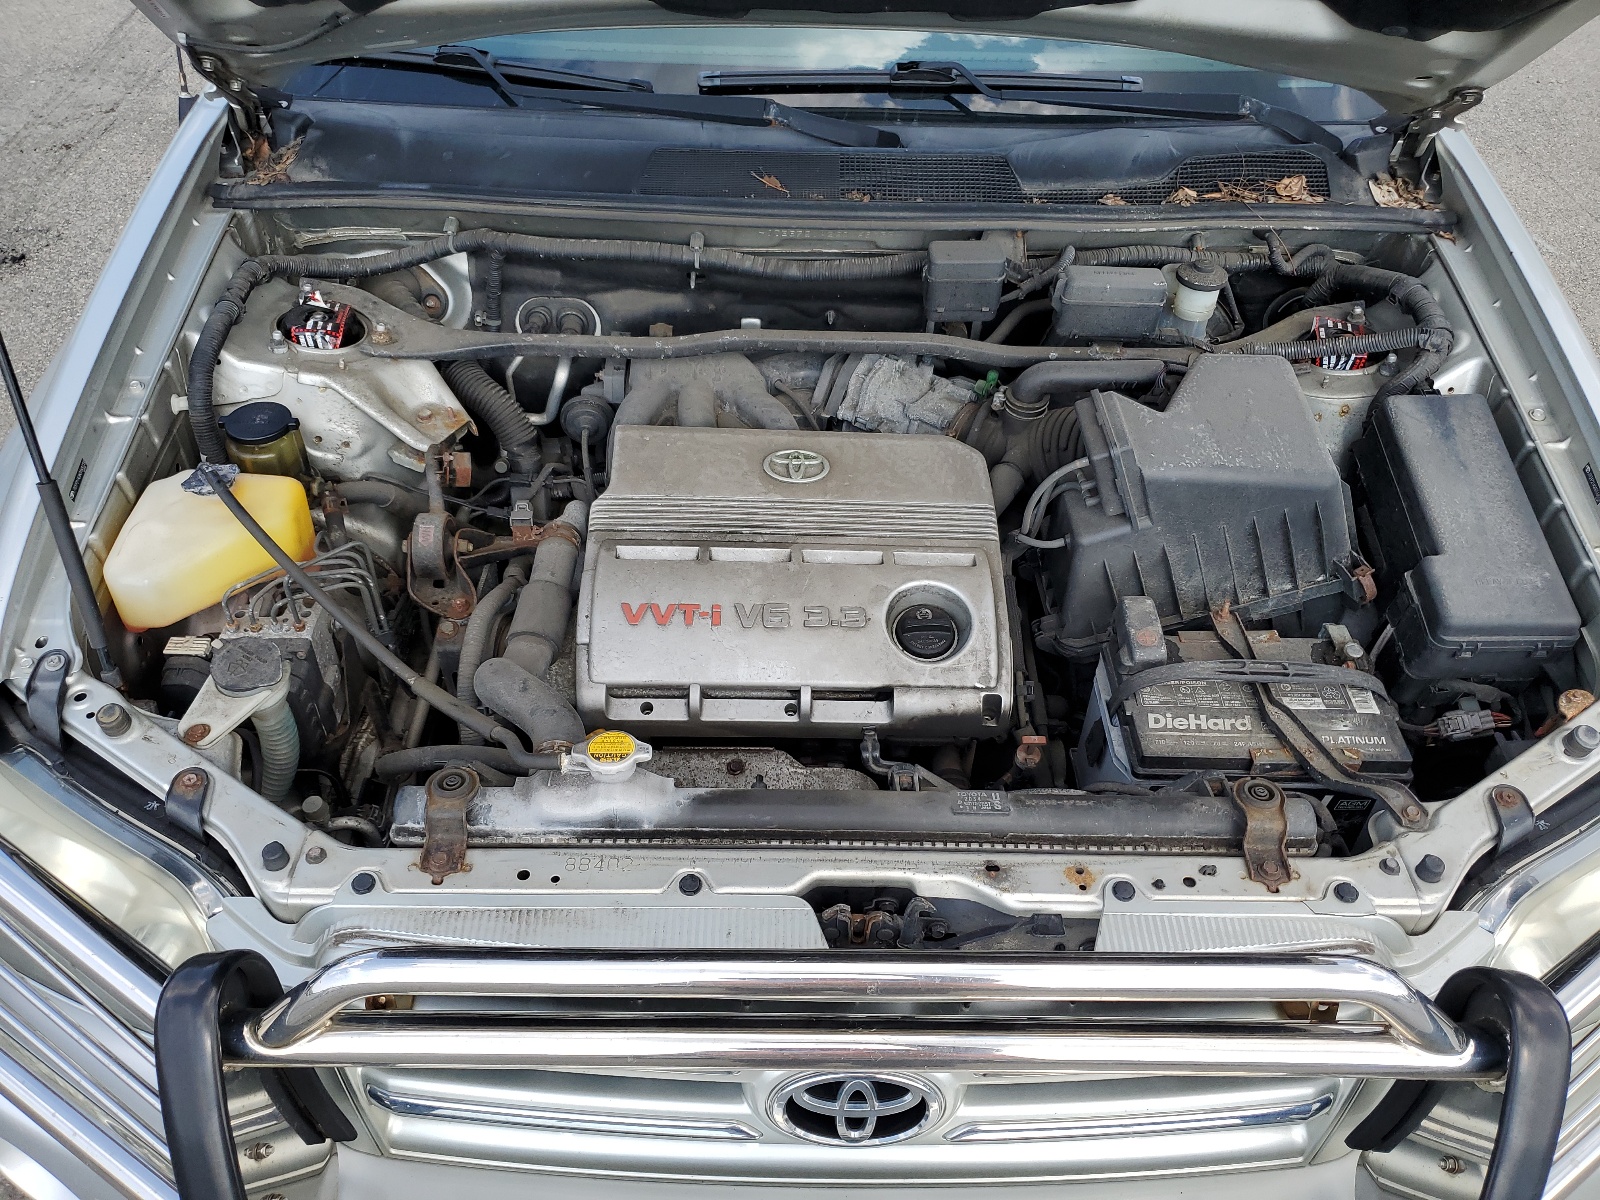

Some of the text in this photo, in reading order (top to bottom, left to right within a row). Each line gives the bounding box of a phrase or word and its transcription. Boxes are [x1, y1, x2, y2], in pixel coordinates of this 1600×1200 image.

[620, 602, 870, 629] VVT-i V6 3.3
[1148, 713, 1252, 731] DieHard
[1321, 735, 1387, 745] PLATINUM
